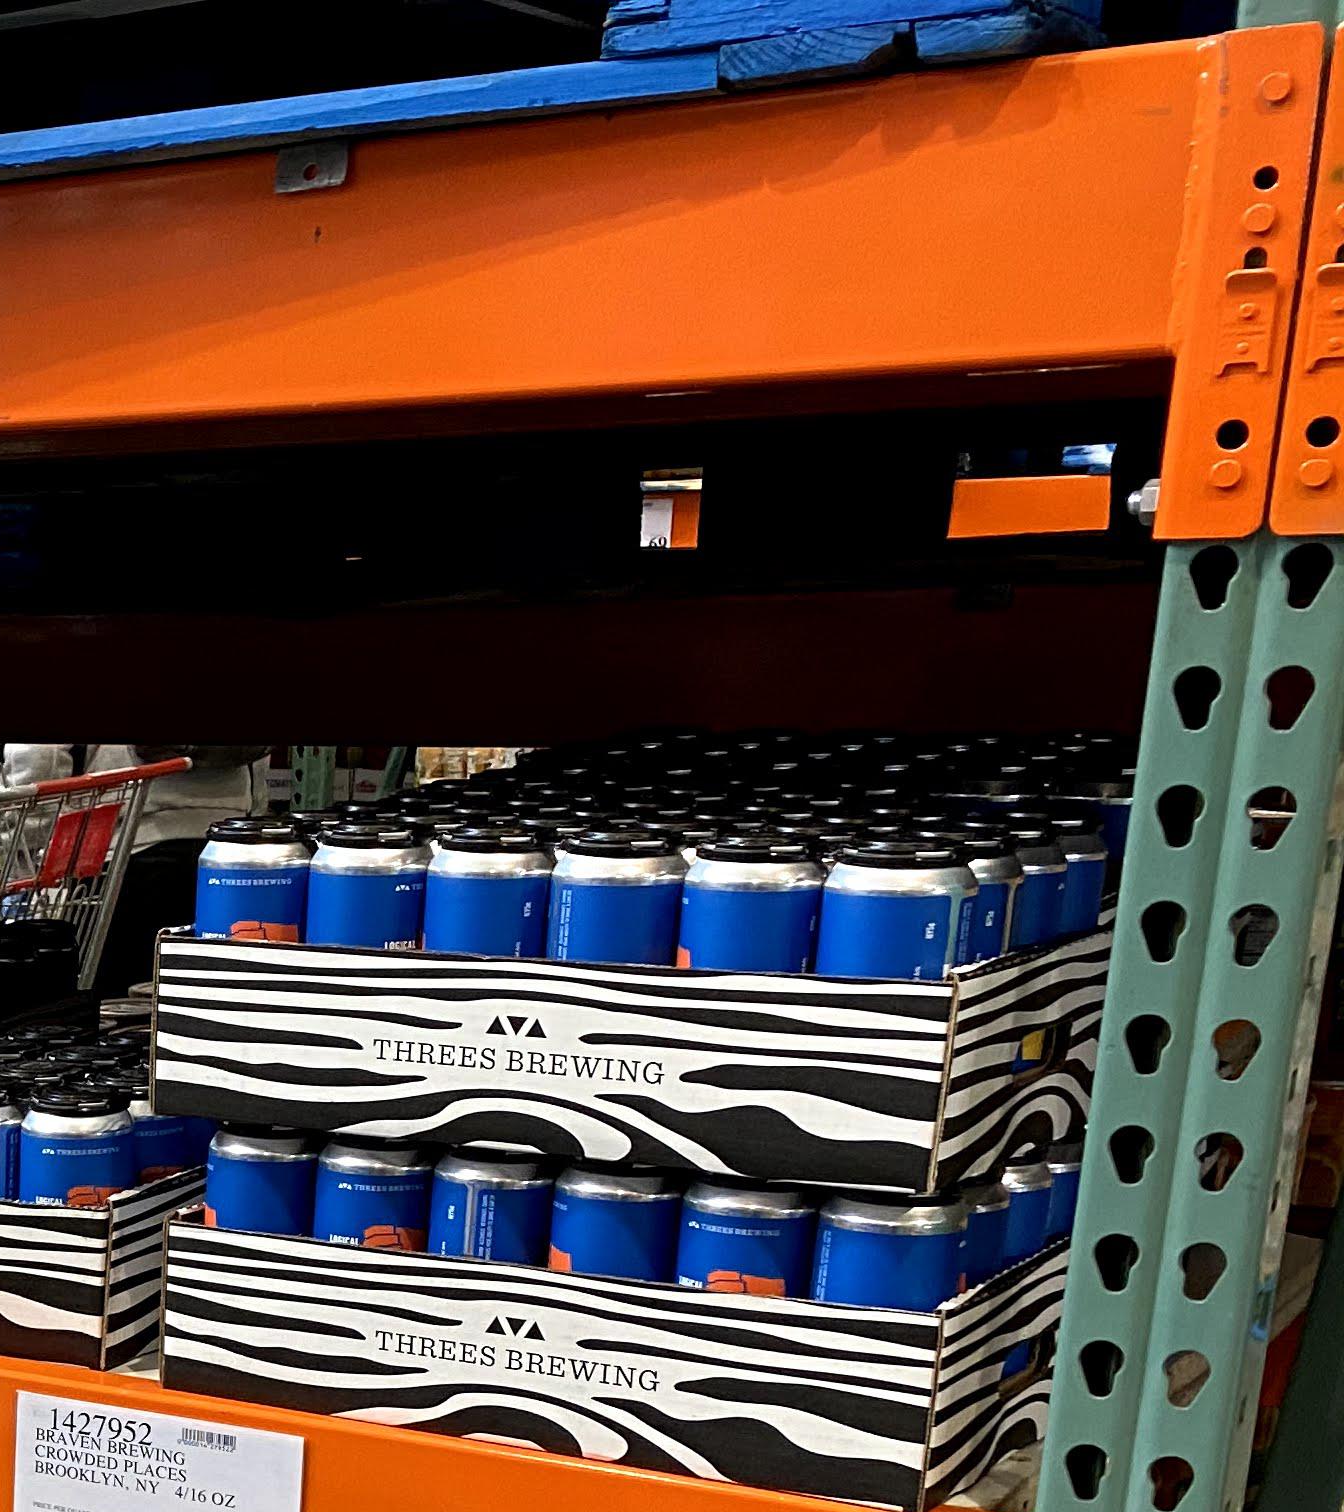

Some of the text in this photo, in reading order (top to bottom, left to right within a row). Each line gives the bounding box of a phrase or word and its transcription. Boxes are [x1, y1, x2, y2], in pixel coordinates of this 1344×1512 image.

[373, 1039, 664, 1087] THREES BREWING
[374, 1330, 660, 1393] THREES BREWING
[36, 1428, 101, 1450] BRAVEN
[108, 1441, 185, 1466] BREWING
[49, 1408, 153, 1446] 1427952
[35, 1445, 187, 1482] CROWDED PLACES
[35, 1460, 236, 1509] BROOKLYN, NY 4/16 OZ
